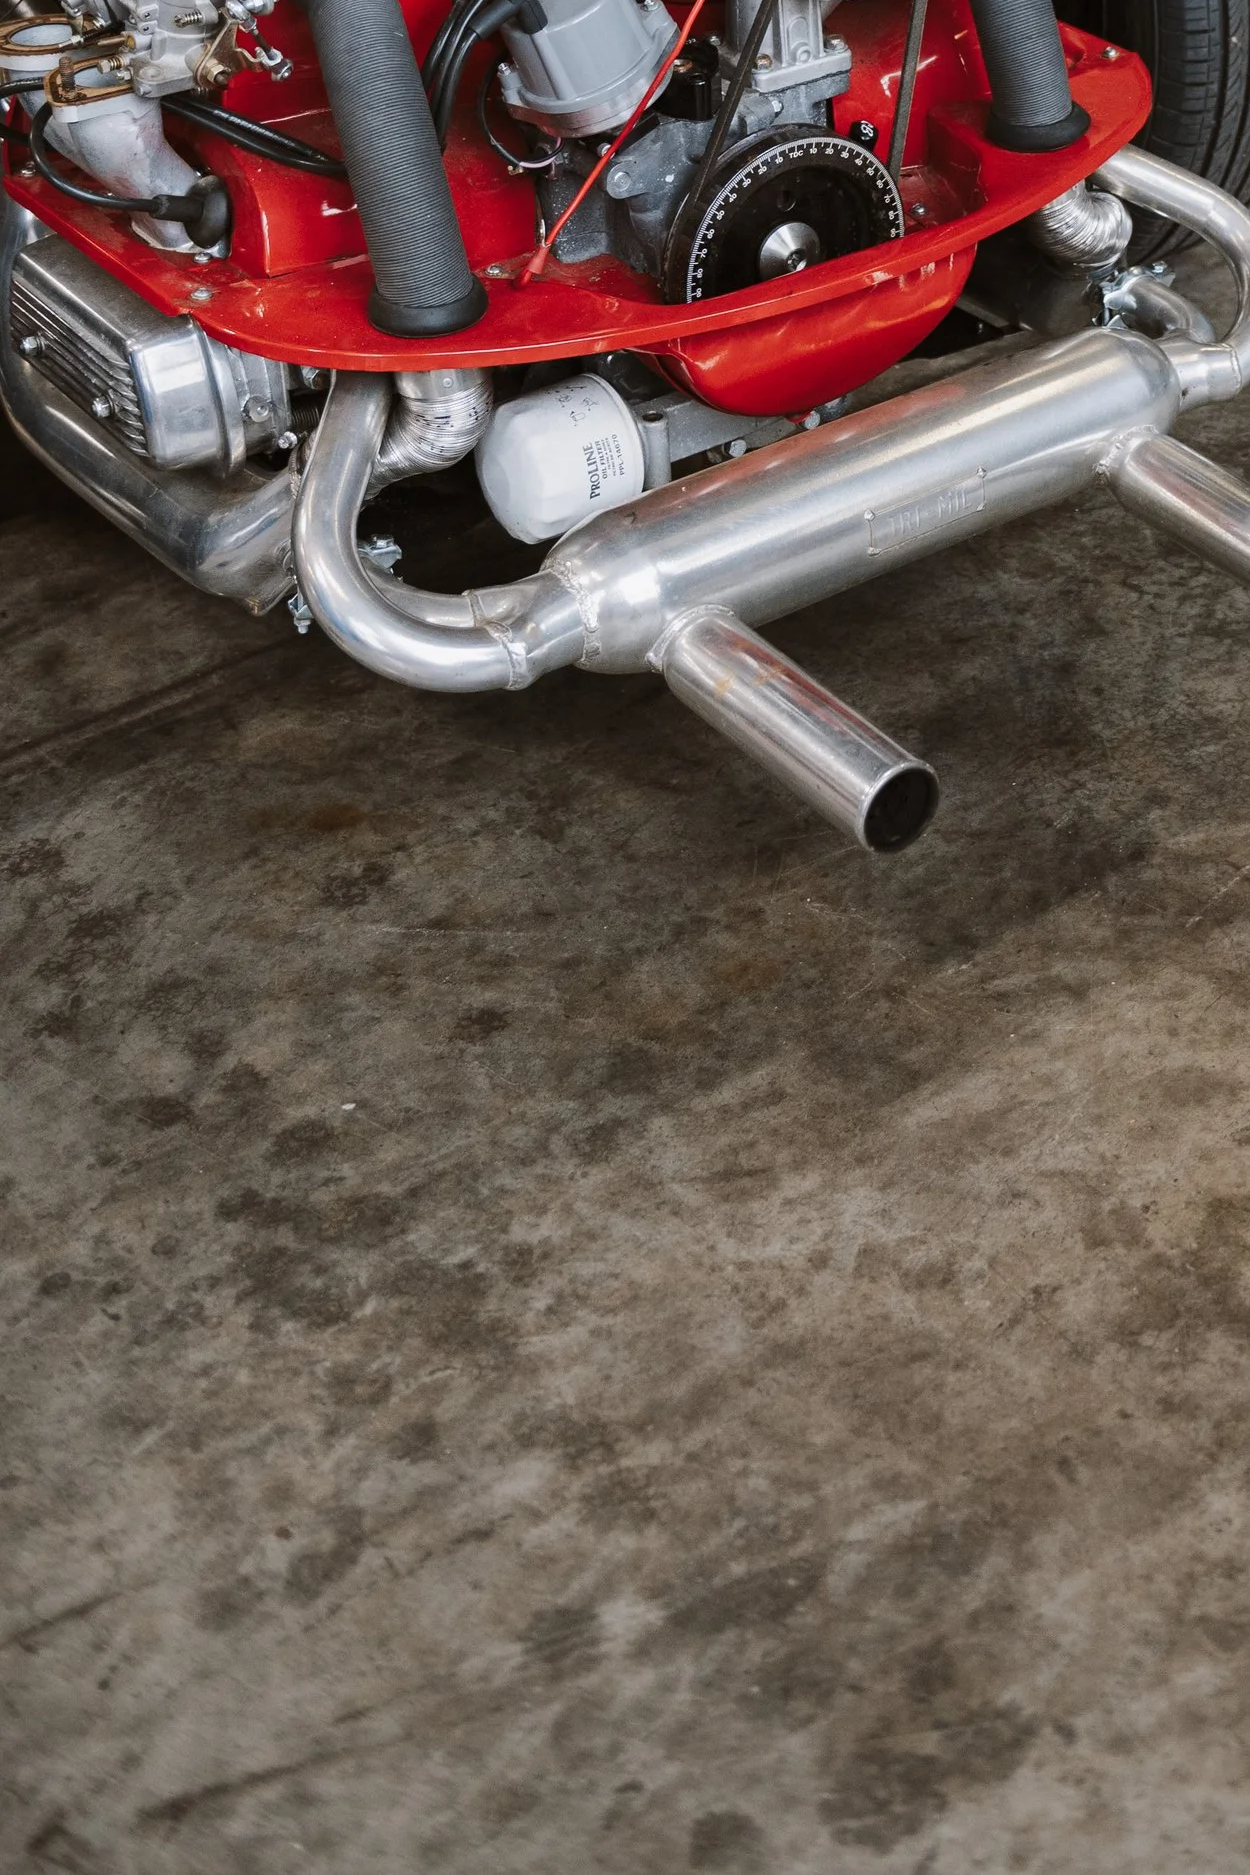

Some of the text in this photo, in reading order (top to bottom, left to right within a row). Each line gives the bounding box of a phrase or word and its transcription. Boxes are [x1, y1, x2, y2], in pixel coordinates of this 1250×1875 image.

[700, 248, 708, 259] 70
[707, 228, 715, 240] 60
[716, 210, 725, 221] 50
[729, 192, 738, 203] 40
[742, 178, 752, 188] 30
[757, 165, 768, 175] 20
[774, 157, 784, 165] 10
[788, 149, 804, 159] TDC
[825, 147, 834, 155] 20
[840, 151, 849, 159] 30
[854, 157, 863, 165] 40
[883, 194, 891, 204] 70
[583, 442, 600, 500] PROLINE
[595, 440, 606, 466] FILTER
[601, 466, 609, 480] OIL
[887, 484, 973, 537] TRI-MIL
